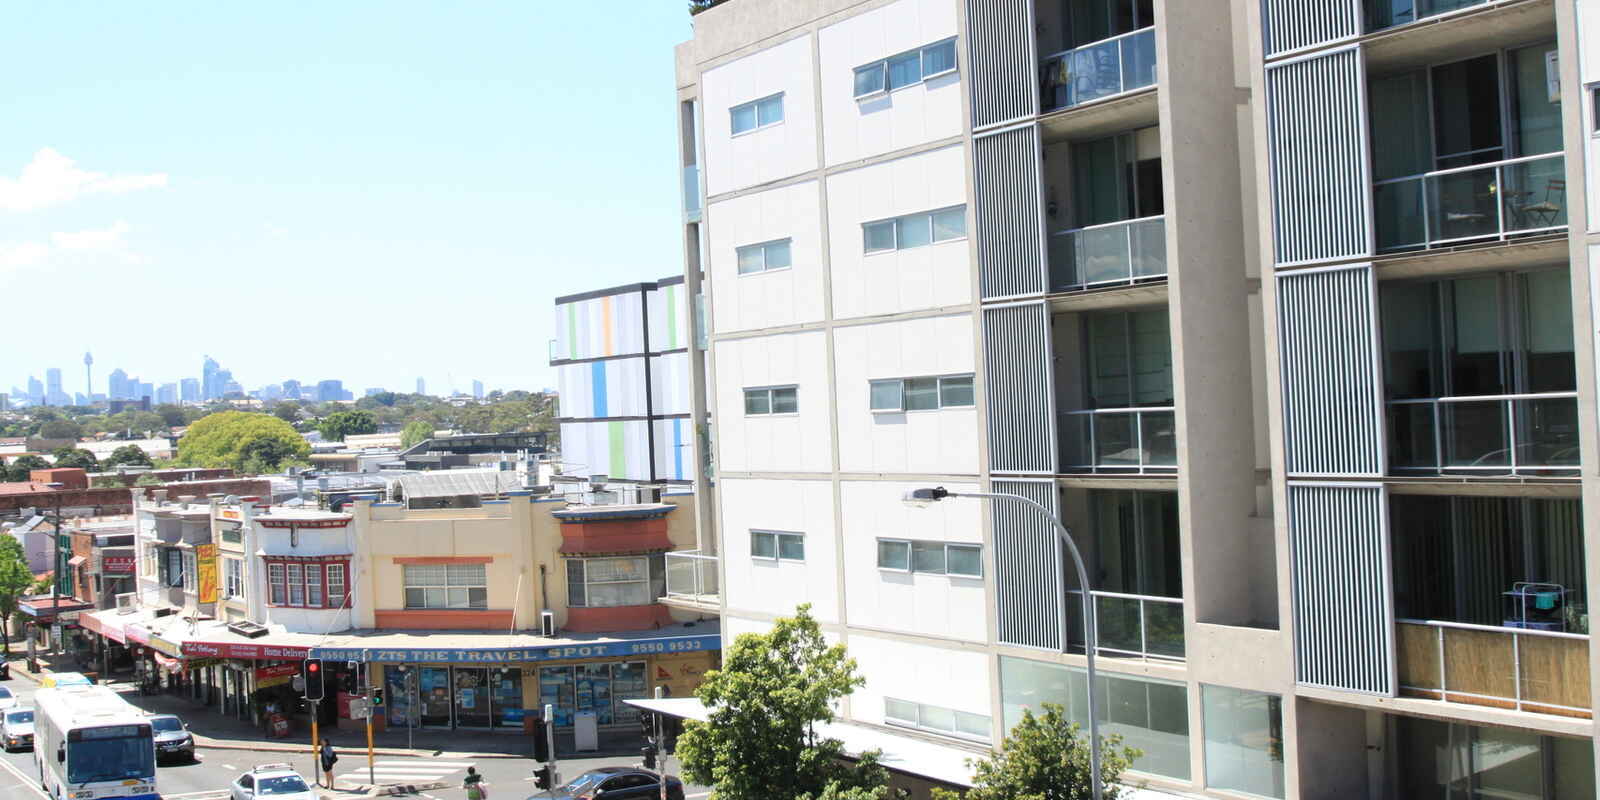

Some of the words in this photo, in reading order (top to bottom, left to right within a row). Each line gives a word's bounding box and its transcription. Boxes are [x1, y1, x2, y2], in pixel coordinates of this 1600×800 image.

[264, 647, 281, 657] Home
[283, 648, 308, 658] Delivery
[632, 643, 664, 653] 9550
[669, 640, 701, 651] 9533
[377, 650, 406, 660] ZTS
[411, 650, 449, 660] THE
[455, 650, 537, 661] TRAVEL
[548, 646, 608, 659] SPOT
